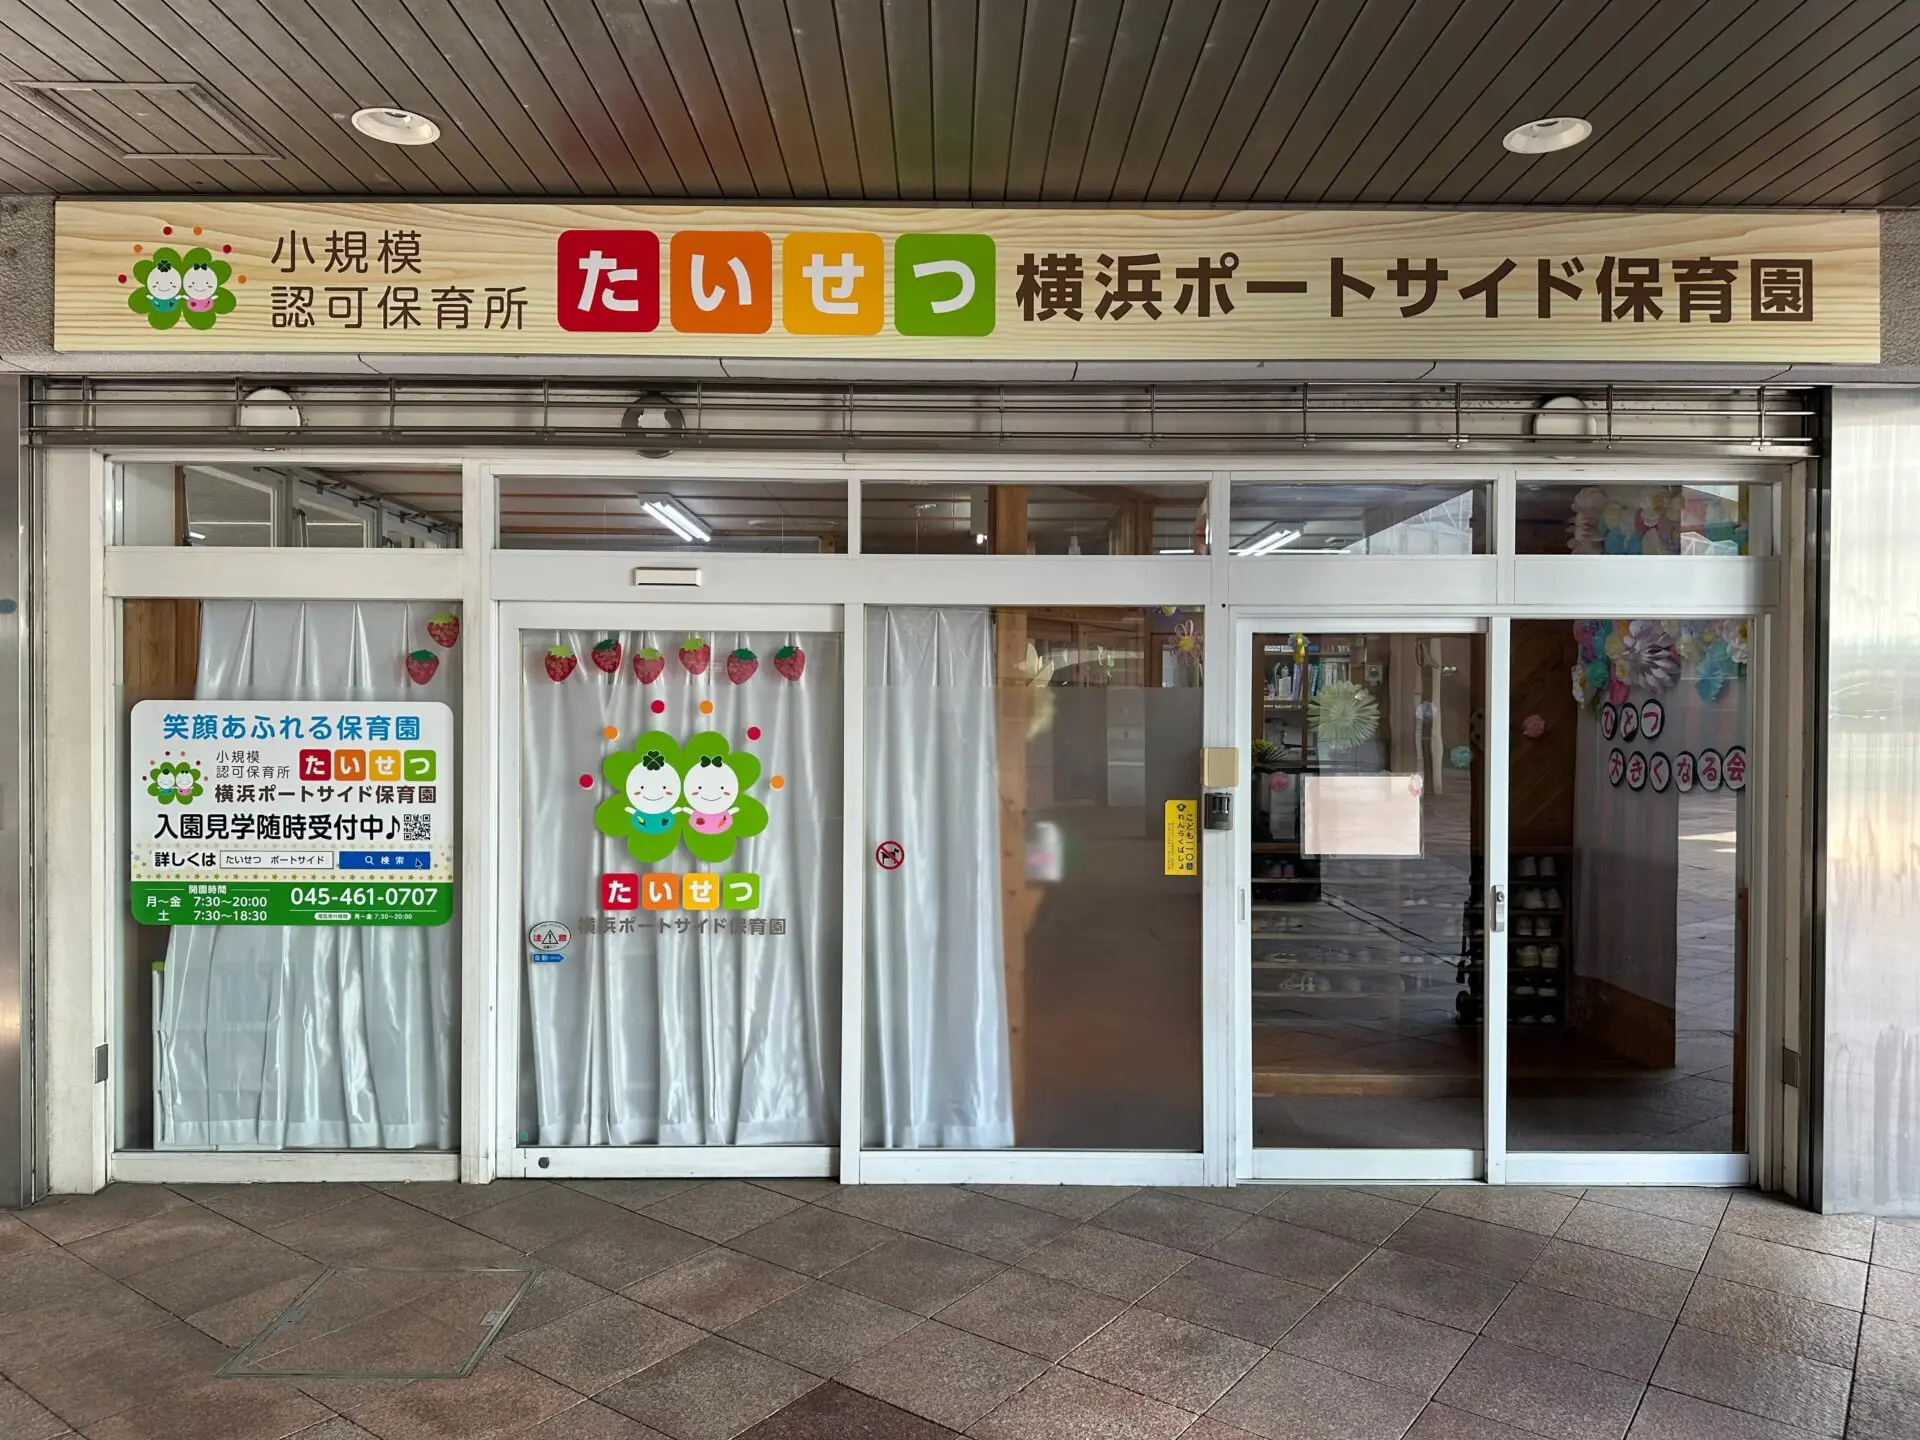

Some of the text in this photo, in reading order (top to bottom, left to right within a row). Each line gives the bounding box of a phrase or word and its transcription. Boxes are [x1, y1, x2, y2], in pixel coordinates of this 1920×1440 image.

[270, 229, 422, 274] 小規模
[575, 248, 1815, 323] たいせつ 横浜ポートサイド保育園
[270, 285, 529, 330] 認可保育所
[162, 713, 420, 741] 笑顔あふれる保育園
[1603, 711, 1659, 735] ひとつ
[215, 749, 260, 764] 小規模
[303, 753, 431, 776] たいせつ
[215, 765, 291, 780] 認可保育所
[1610, 752, 1746, 784] 大きくなる会
[214, 783, 437, 804] 横浜ポートサイド保育園
[154, 851, 325, 868] 詳しくは たいせつ ポートサイド
[380, 855, 405, 866] 検索
[188, 884, 227, 894] 開園時間
[290, 887, 438, 906] 045-461-0707
[607, 879, 754, 904] たいせつ
[158, 909, 170, 922] 土
[578, 916, 787, 936] 横浜ポートサイド保育園
